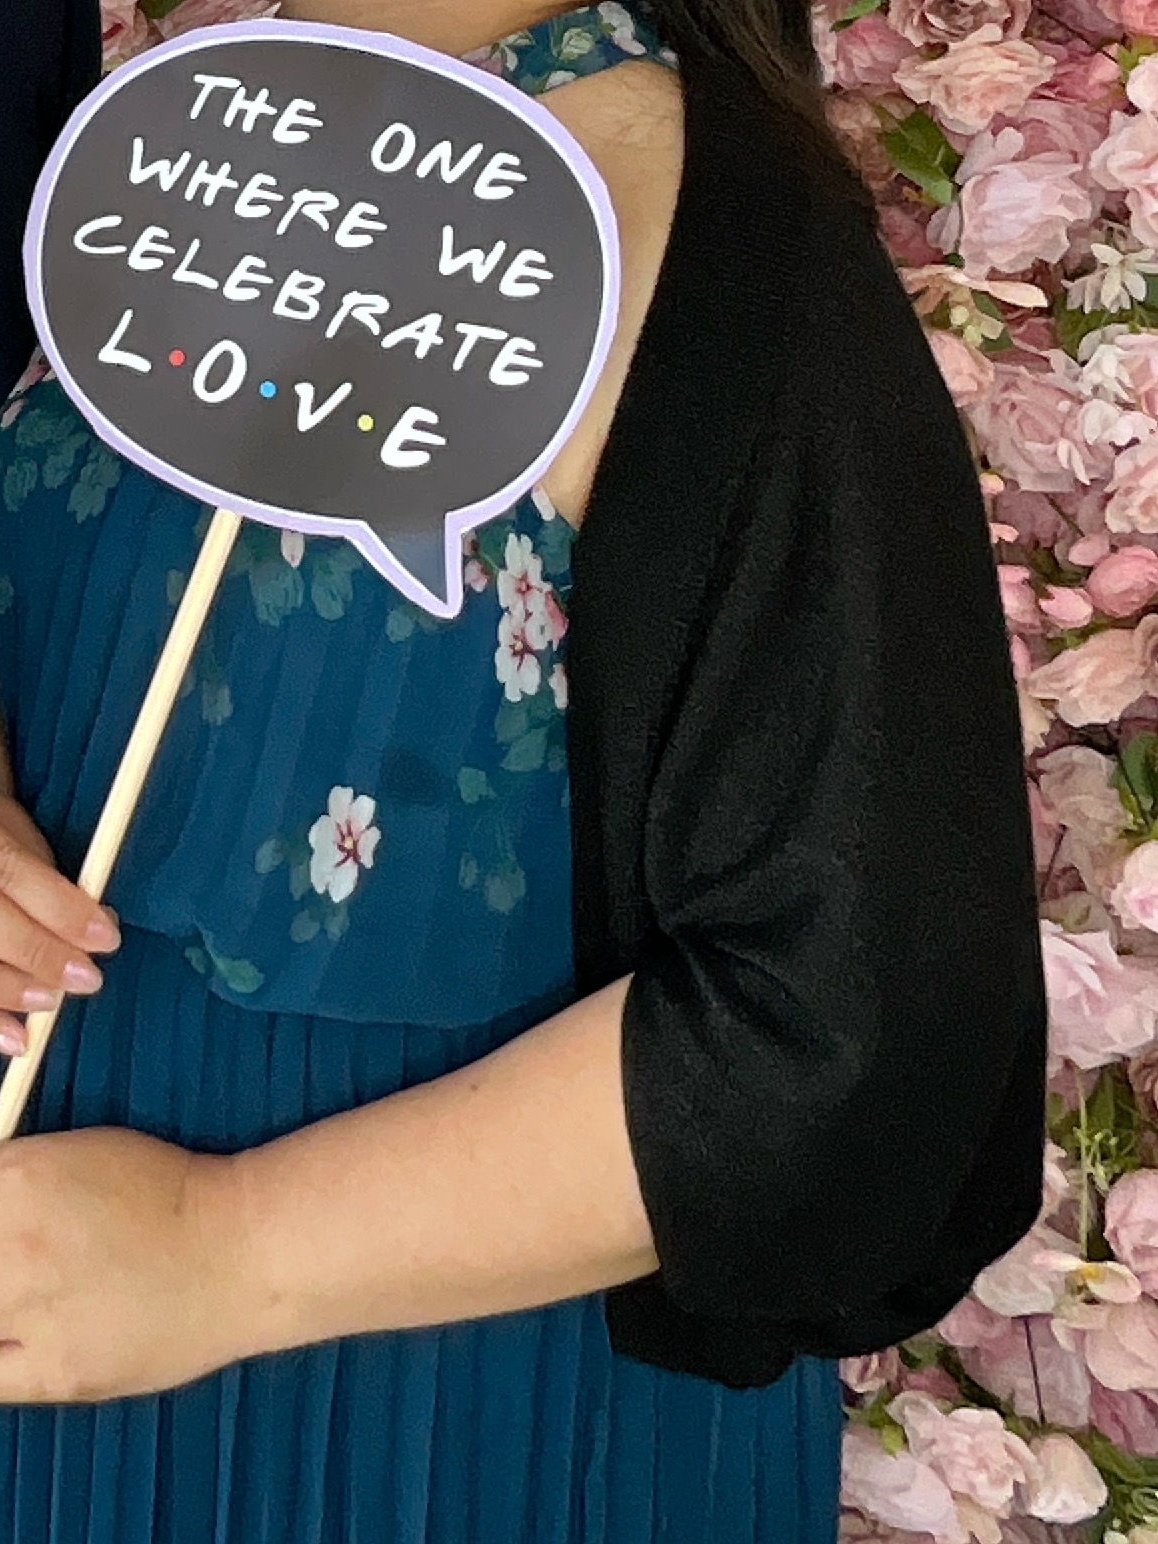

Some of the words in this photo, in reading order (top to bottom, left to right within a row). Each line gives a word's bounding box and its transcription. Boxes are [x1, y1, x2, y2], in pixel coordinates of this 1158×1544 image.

[128, 136, 388, 248] WHERE
[438, 225, 554, 298] WE
[189, 73, 324, 144] THE
[370, 122, 528, 200] ONE
[73, 214, 544, 386] CELEBRATE
